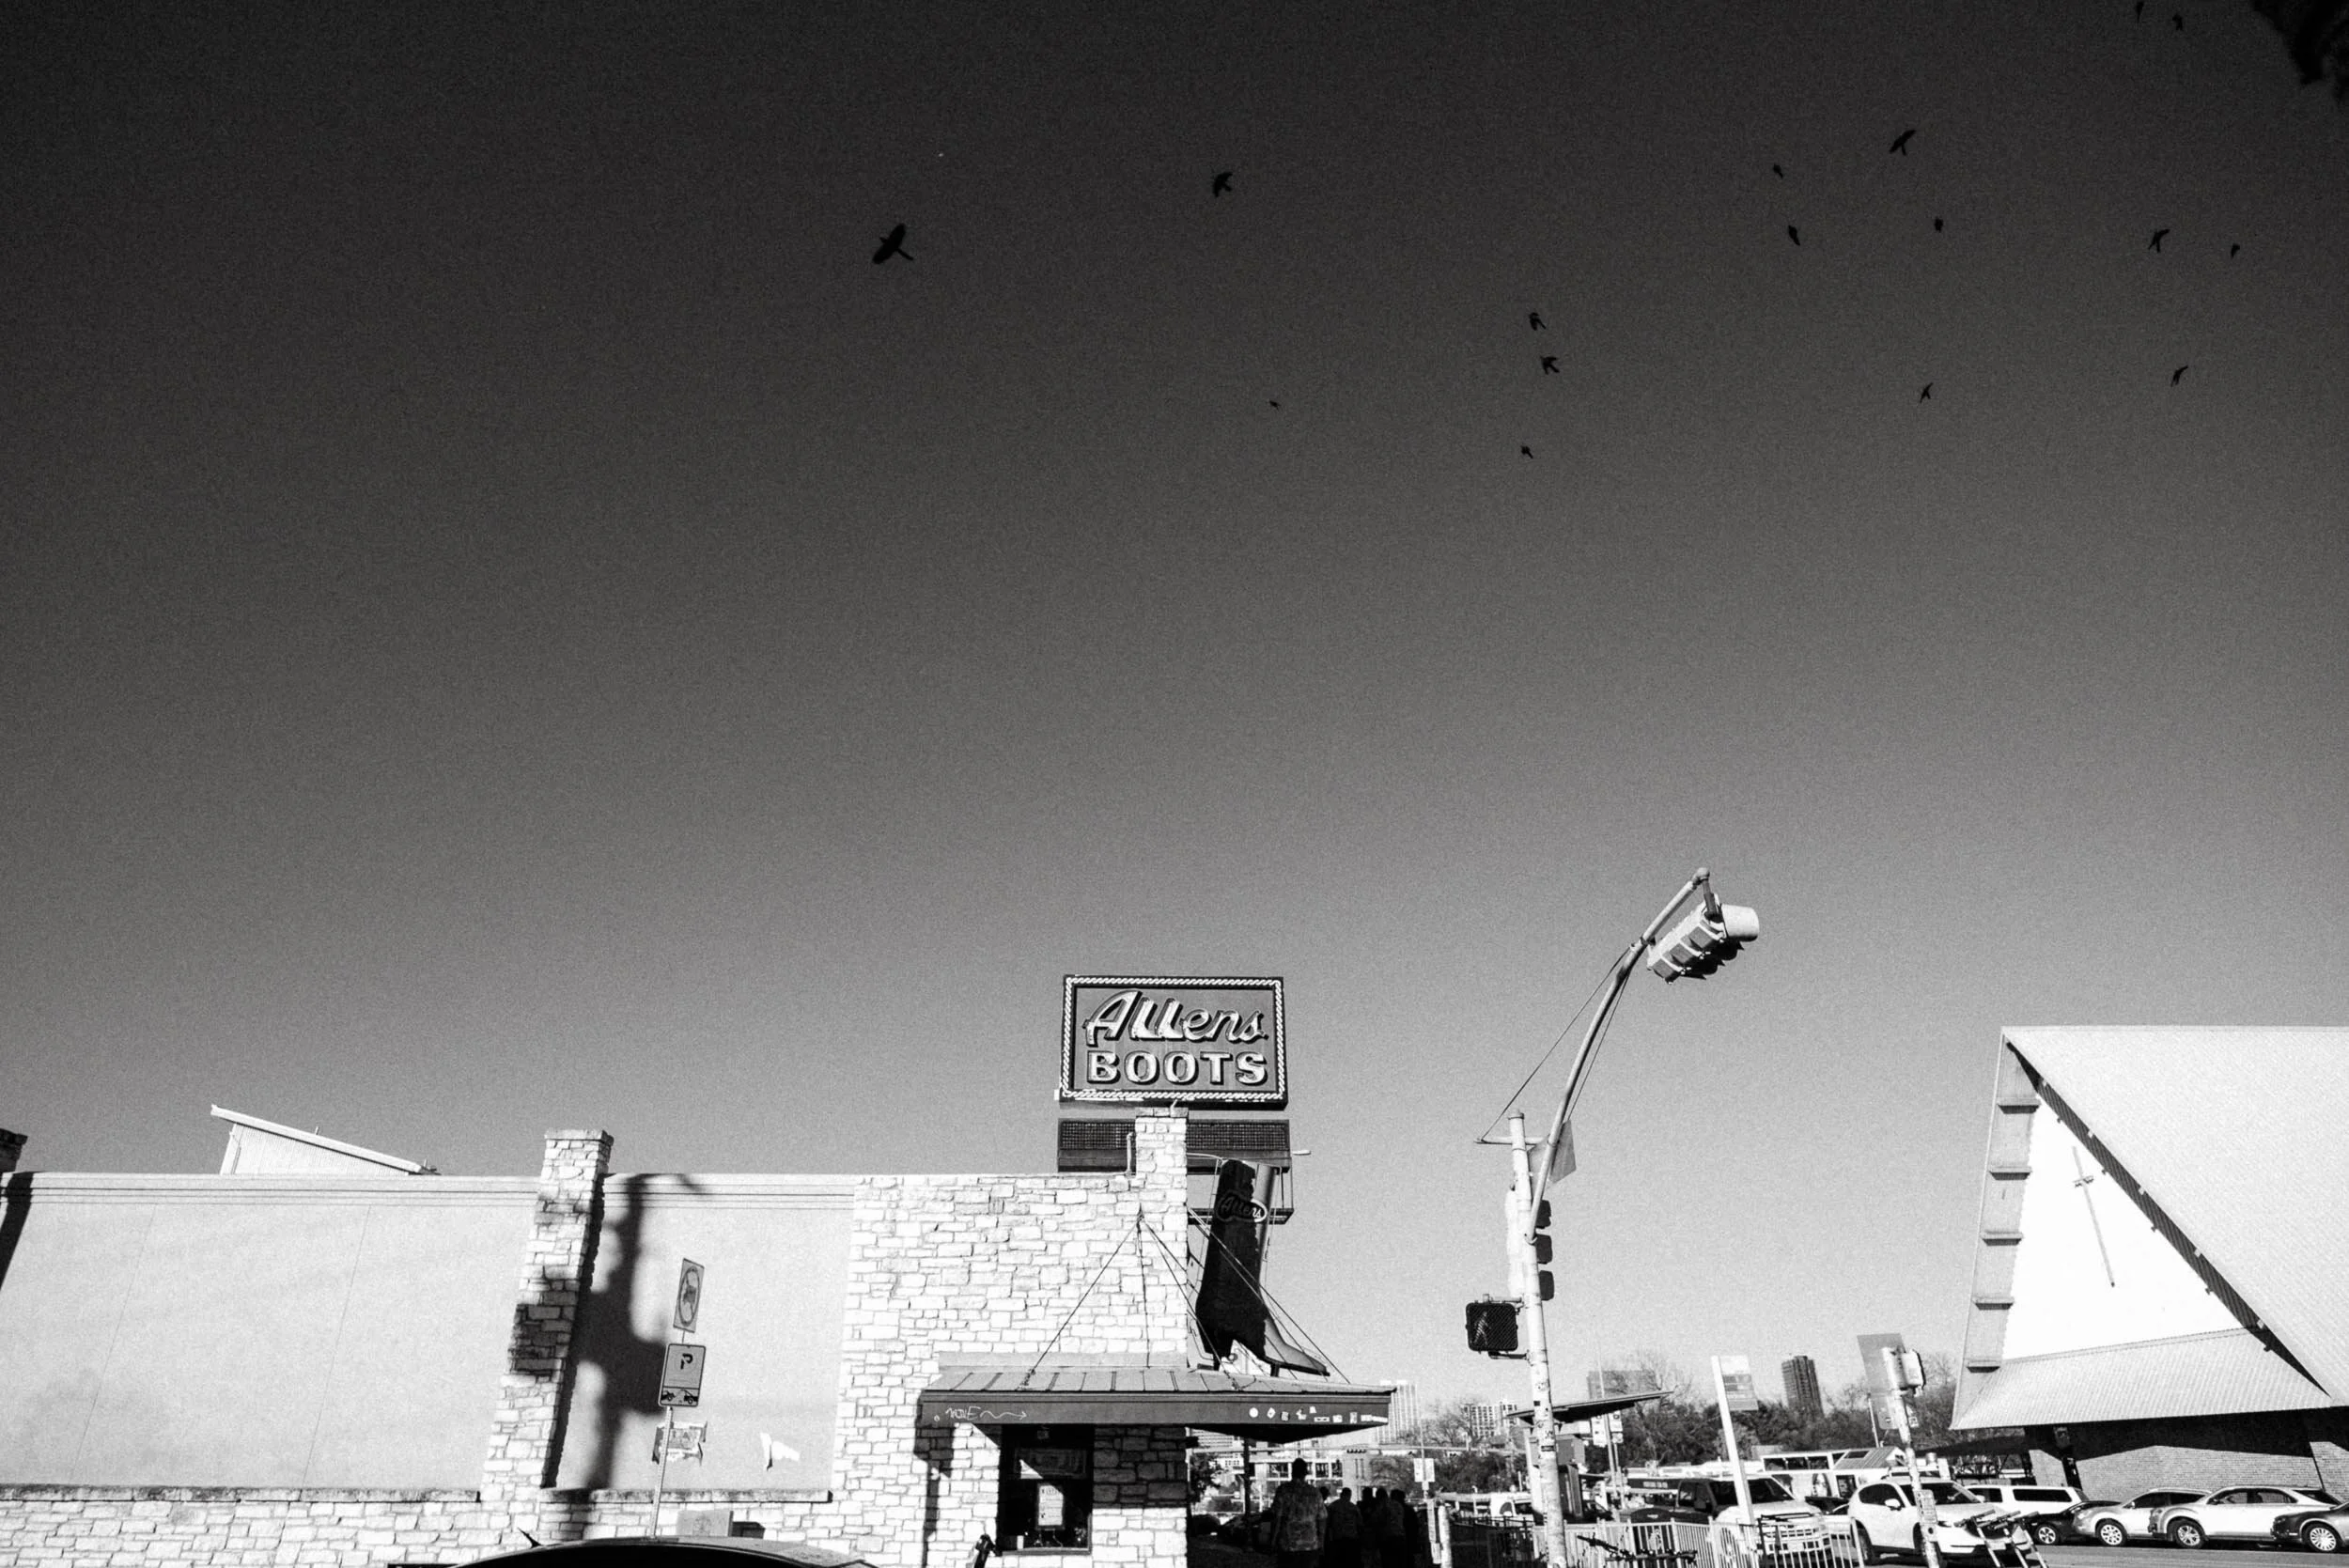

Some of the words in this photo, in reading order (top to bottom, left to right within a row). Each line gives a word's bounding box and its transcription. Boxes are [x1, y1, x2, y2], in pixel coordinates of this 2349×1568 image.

[1083, 990, 1268, 1047] Allens
[1087, 1050, 1268, 1085] BOOTS
[1221, 1195, 1262, 1219] Allens
